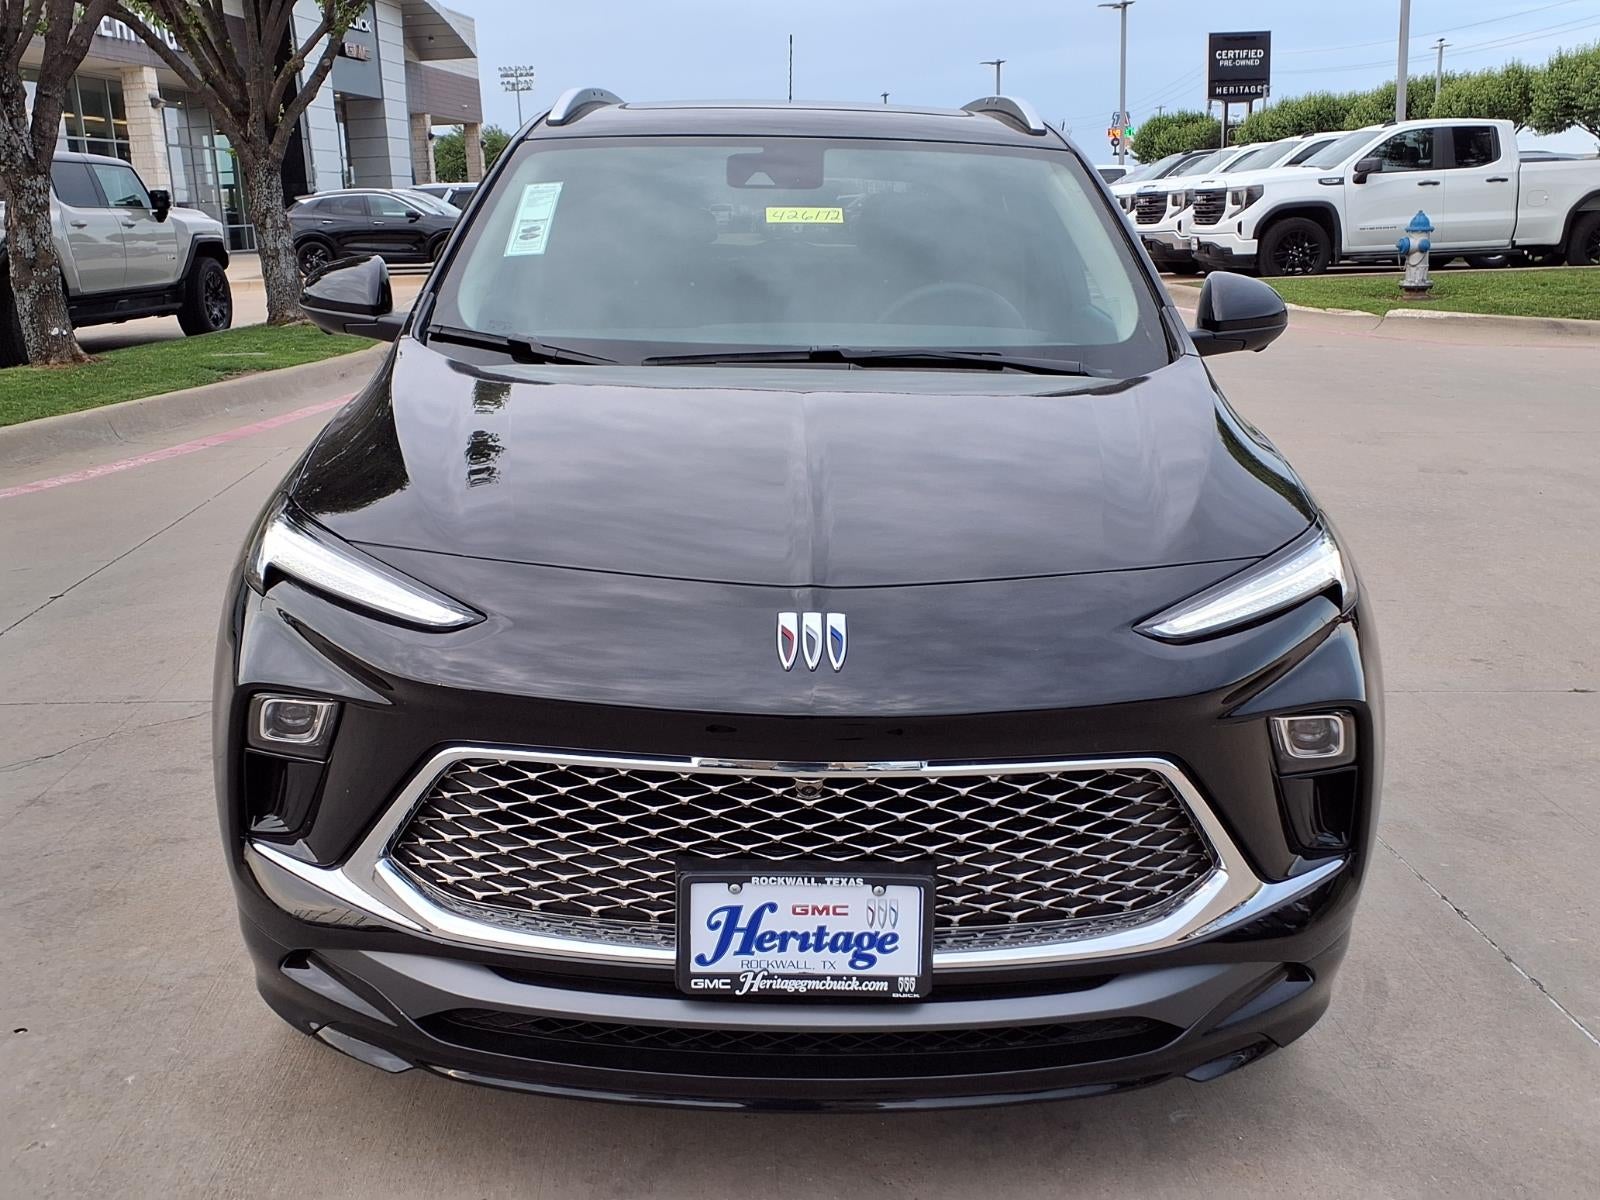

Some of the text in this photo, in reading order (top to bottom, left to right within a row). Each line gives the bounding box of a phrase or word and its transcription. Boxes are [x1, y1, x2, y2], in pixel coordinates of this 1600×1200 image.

[1215, 49, 1264, 60] CERTIFIED
[1219, 59, 1260, 67] PRE-OWNED
[751, 876, 864, 887] ROCKWALL, TEXAS
[791, 904, 849, 916] GMC
[694, 901, 900, 970] Heritage
[821, 960, 837, 970] TX
[691, 969, 888, 995] GMC Heritagegmcbuick.com
